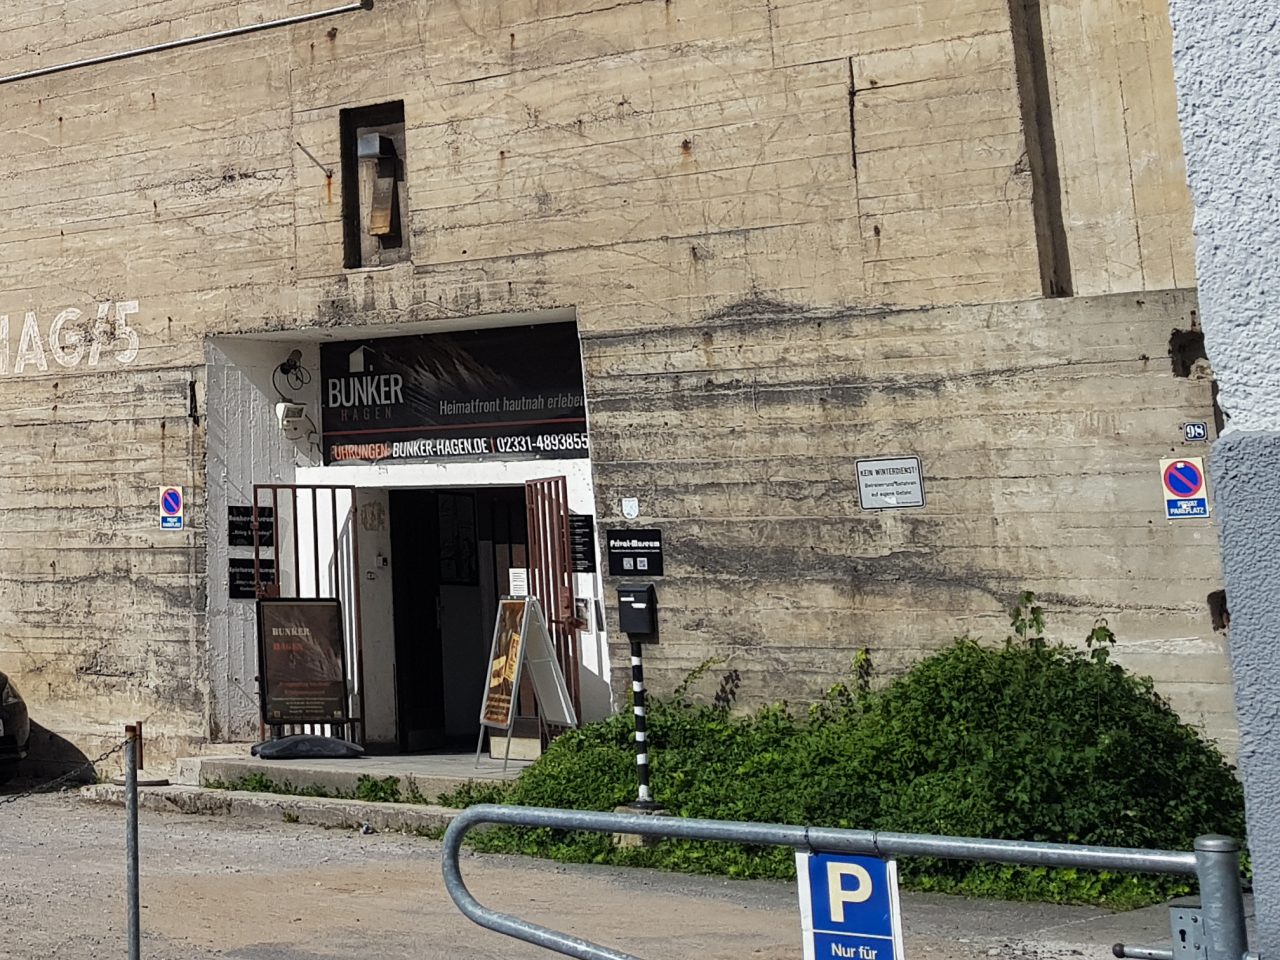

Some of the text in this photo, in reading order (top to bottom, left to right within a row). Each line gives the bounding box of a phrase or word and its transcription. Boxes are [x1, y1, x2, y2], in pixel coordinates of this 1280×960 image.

[328, 373, 404, 408] BUNKER
[340, 406, 392, 423] HAGEN
[439, 396, 501, 416] Heimatfront
[503, 394, 545, 412] hautnah
[1186, 424, 1205, 438] 98
[392, 437, 489, 458] BUNKER-HAGEN.DE
[496, 433, 589, 454] 02331-4893855
[271, 627, 311, 637] BUNKER
[826, 861, 873, 923] P
[830, 942, 878, 960] Nur für
